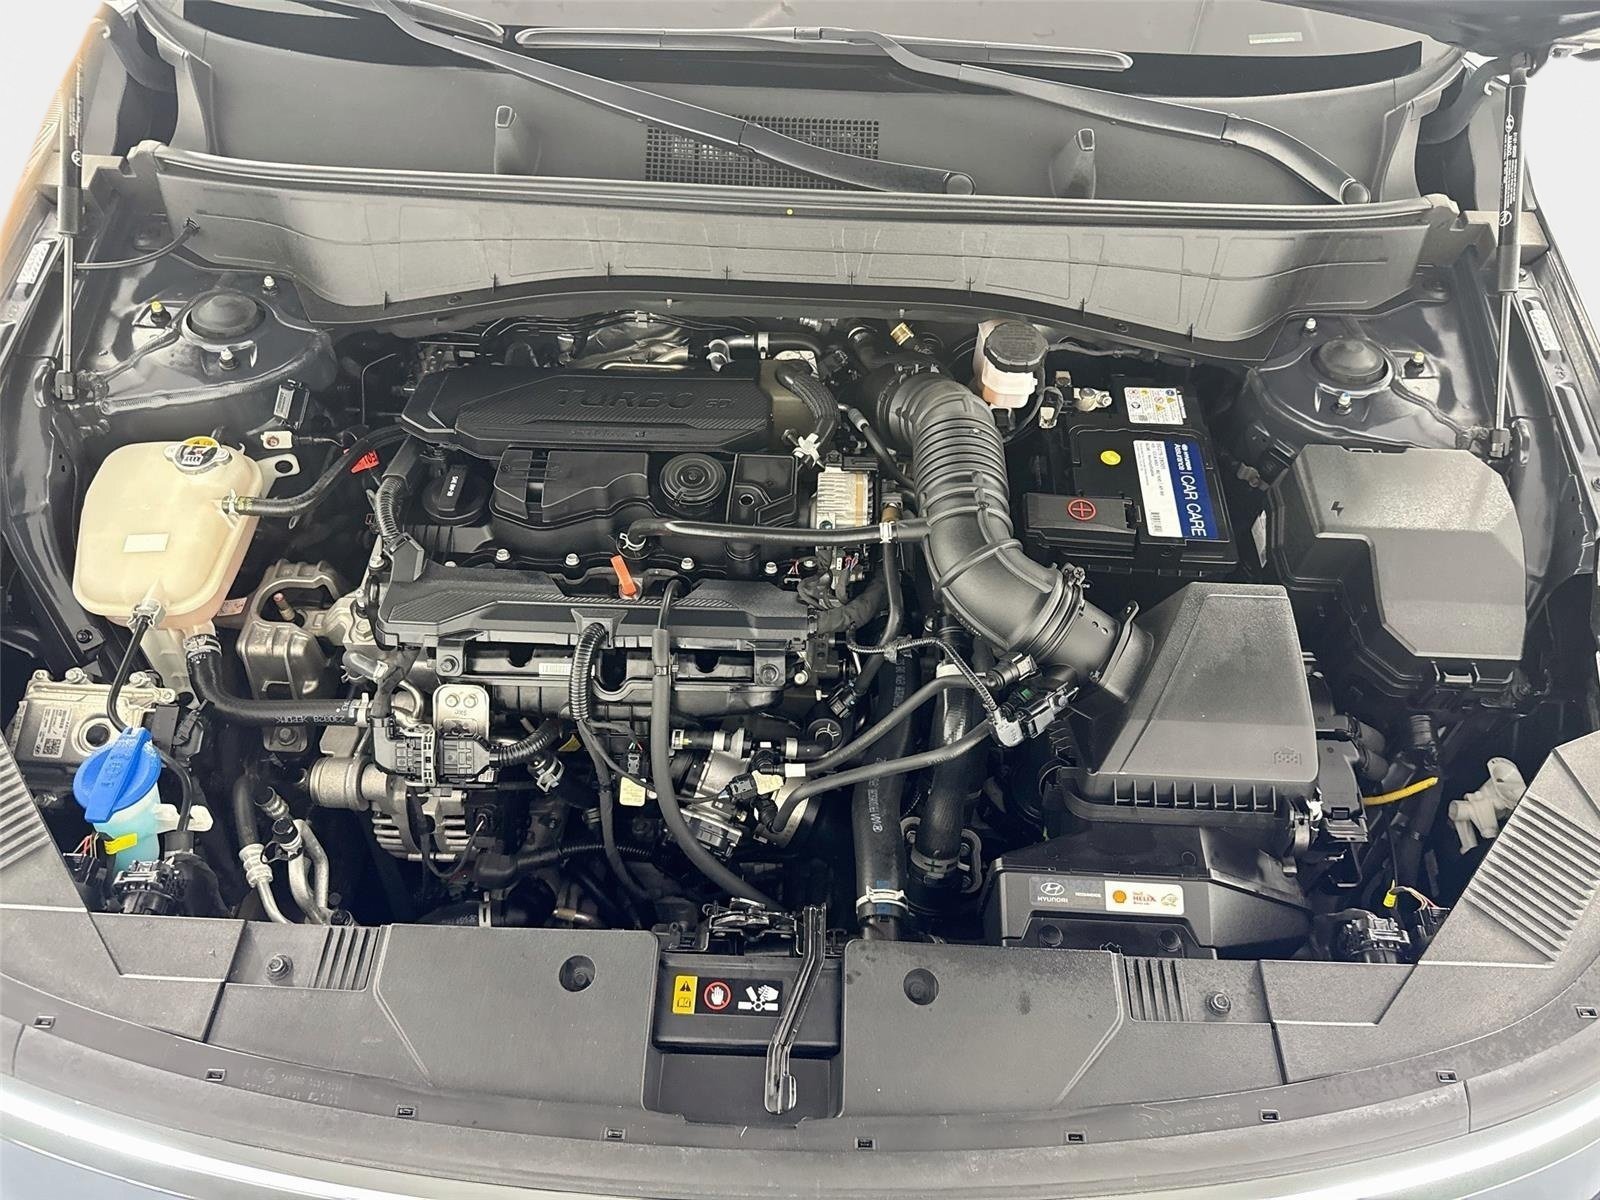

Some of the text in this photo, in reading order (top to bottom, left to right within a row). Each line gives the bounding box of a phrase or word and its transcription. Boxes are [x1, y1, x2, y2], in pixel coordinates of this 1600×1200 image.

[556, 389, 694, 410] TURBO
[1174, 443, 1185, 471] Assurance
[1180, 475, 1207, 537] CAR CARE
